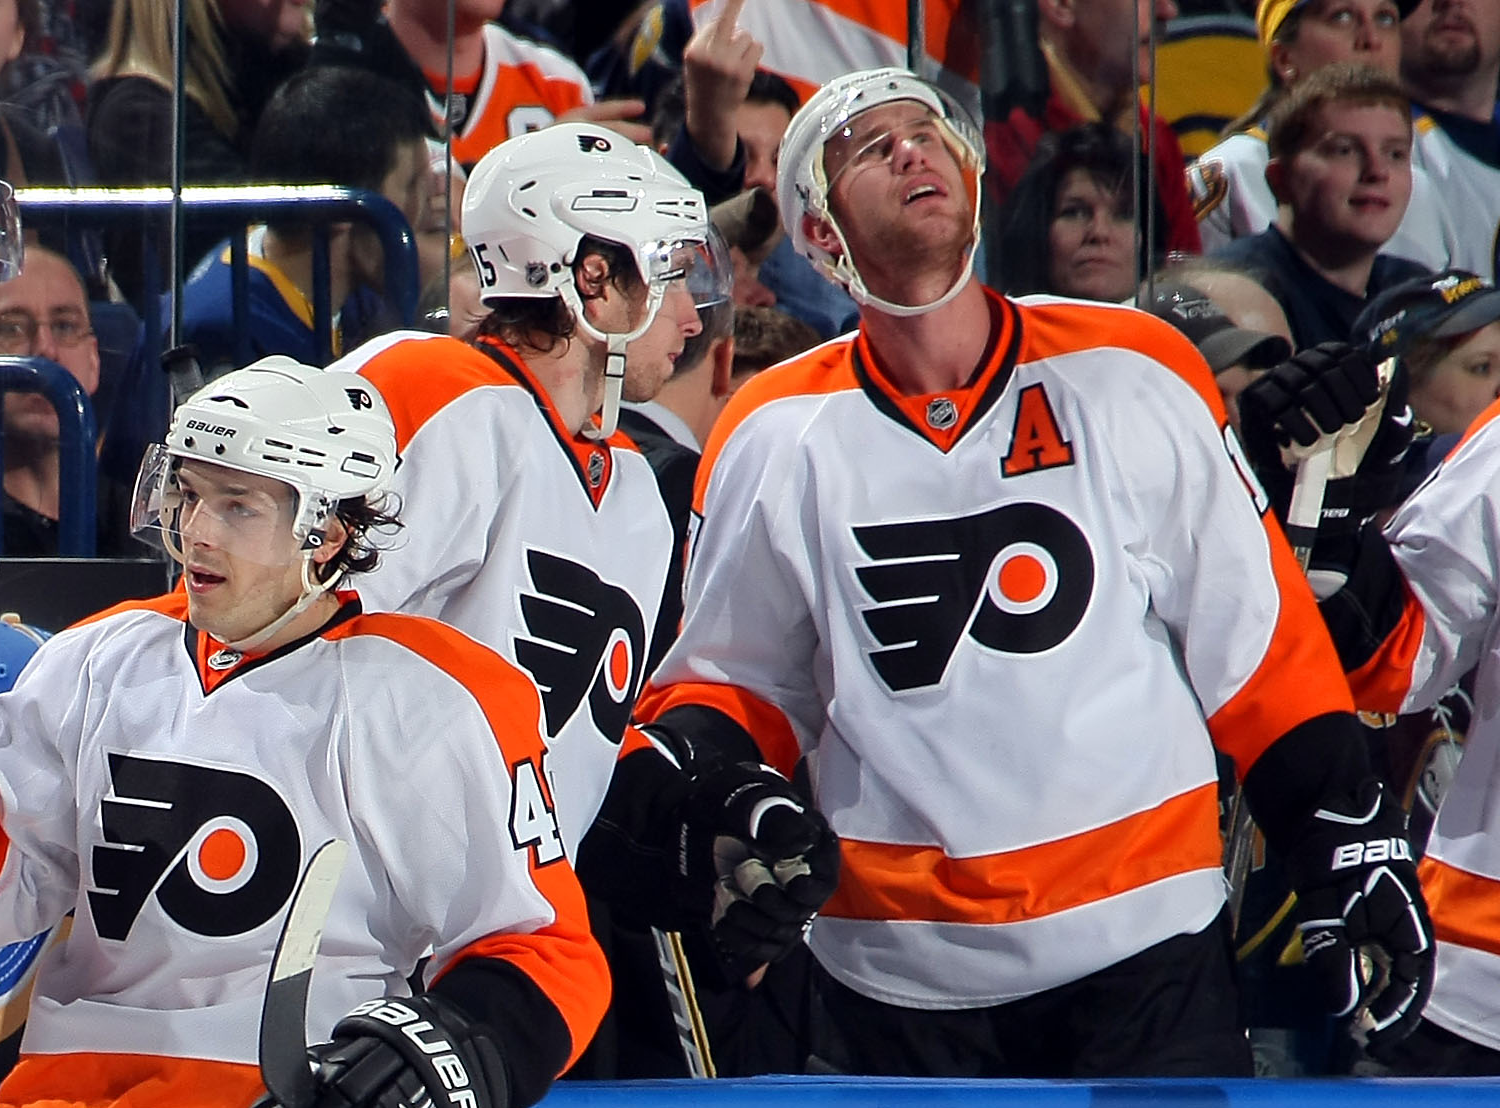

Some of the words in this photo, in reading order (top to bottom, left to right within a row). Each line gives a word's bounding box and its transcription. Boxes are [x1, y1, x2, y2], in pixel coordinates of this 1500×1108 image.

[185, 419, 237, 438] BAUER
[1001, 382, 1073, 477] A
[508, 749, 566, 870] 4
